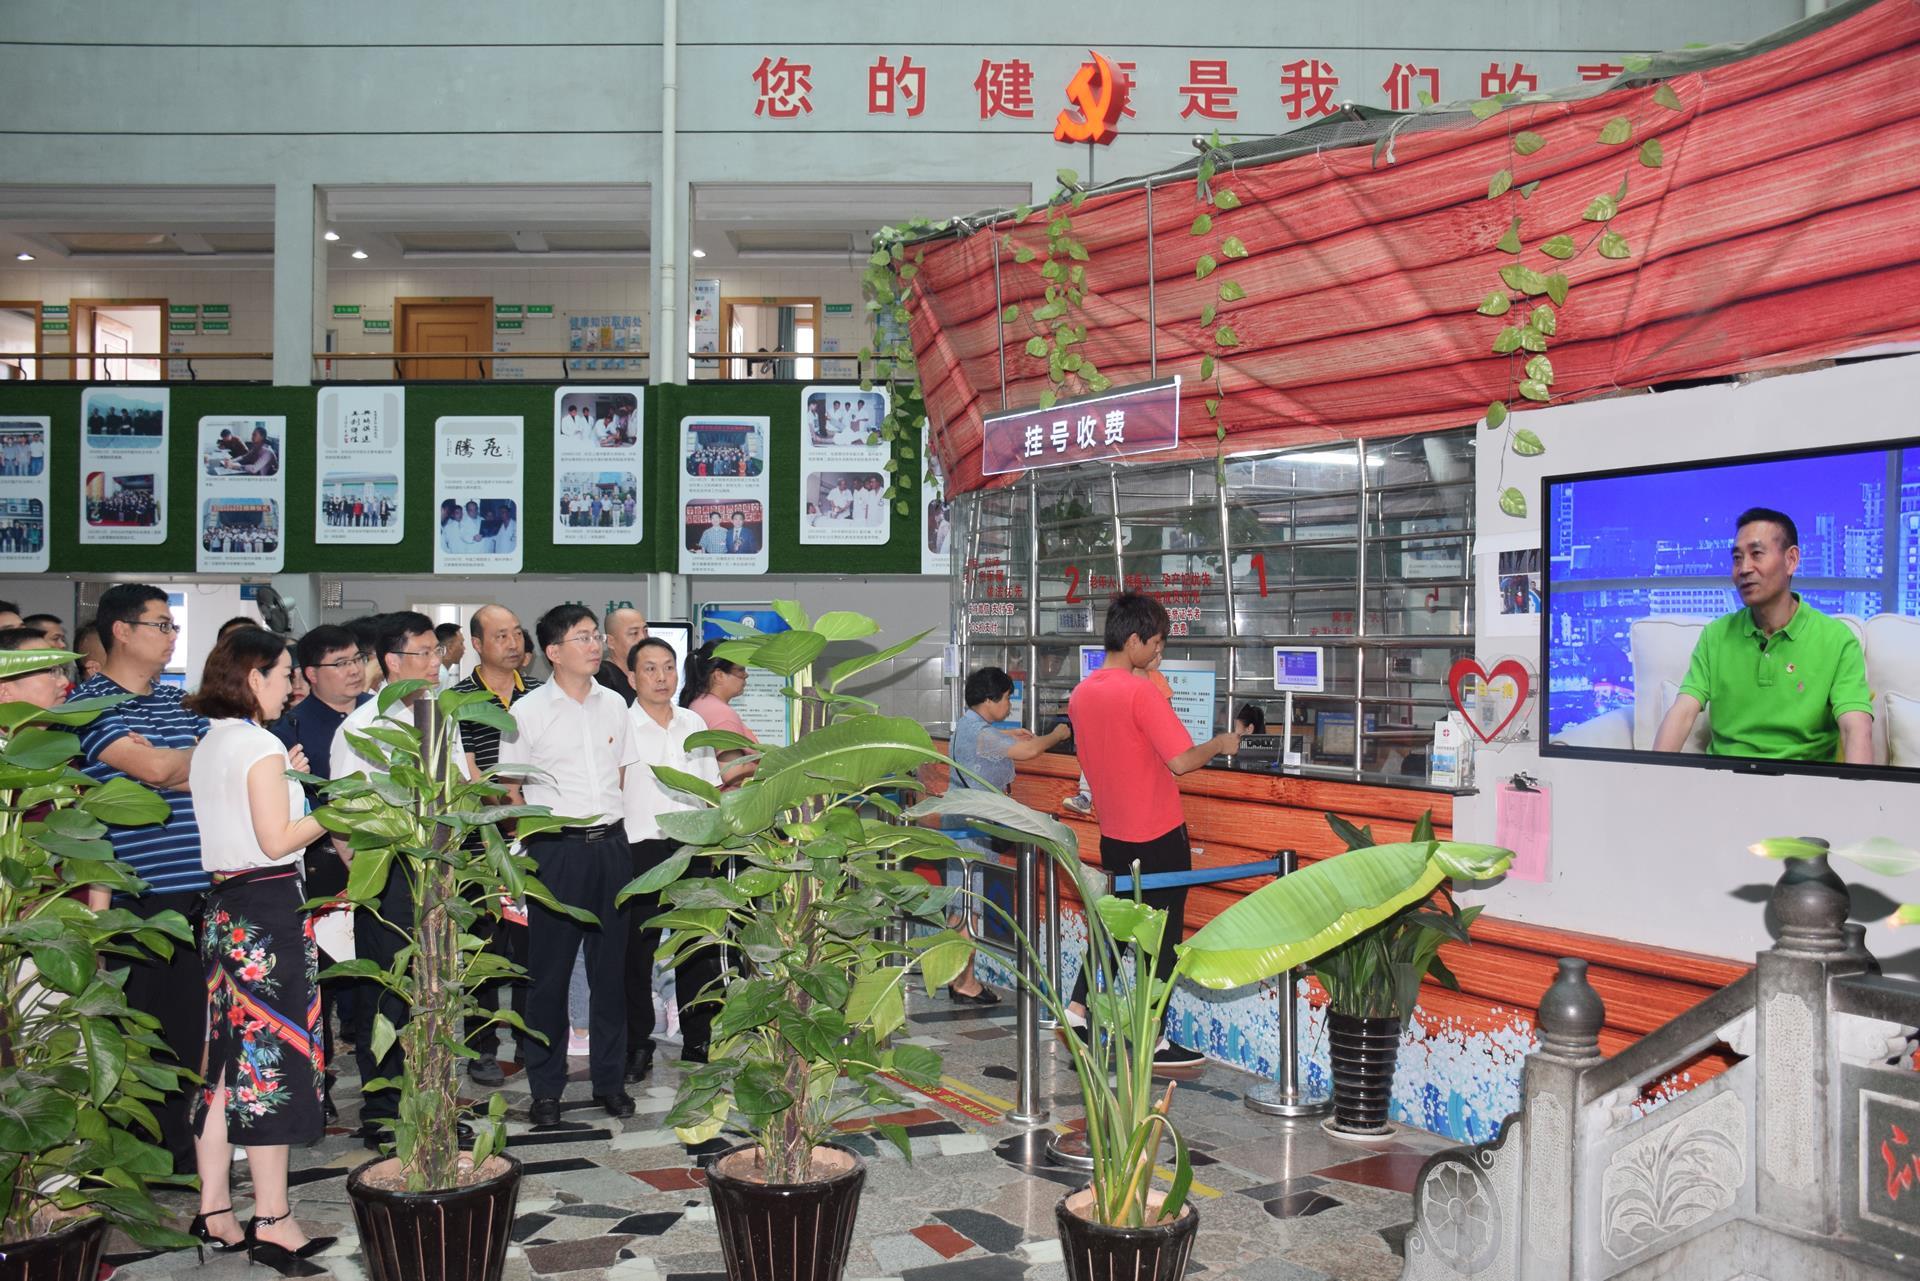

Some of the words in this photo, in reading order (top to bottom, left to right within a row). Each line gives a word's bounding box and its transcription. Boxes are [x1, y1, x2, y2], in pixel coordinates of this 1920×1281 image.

[1024, 410, 1125, 458] 挂号收费
[1065, 565, 1082, 604] 2
[1250, 553, 1268, 598] 1
